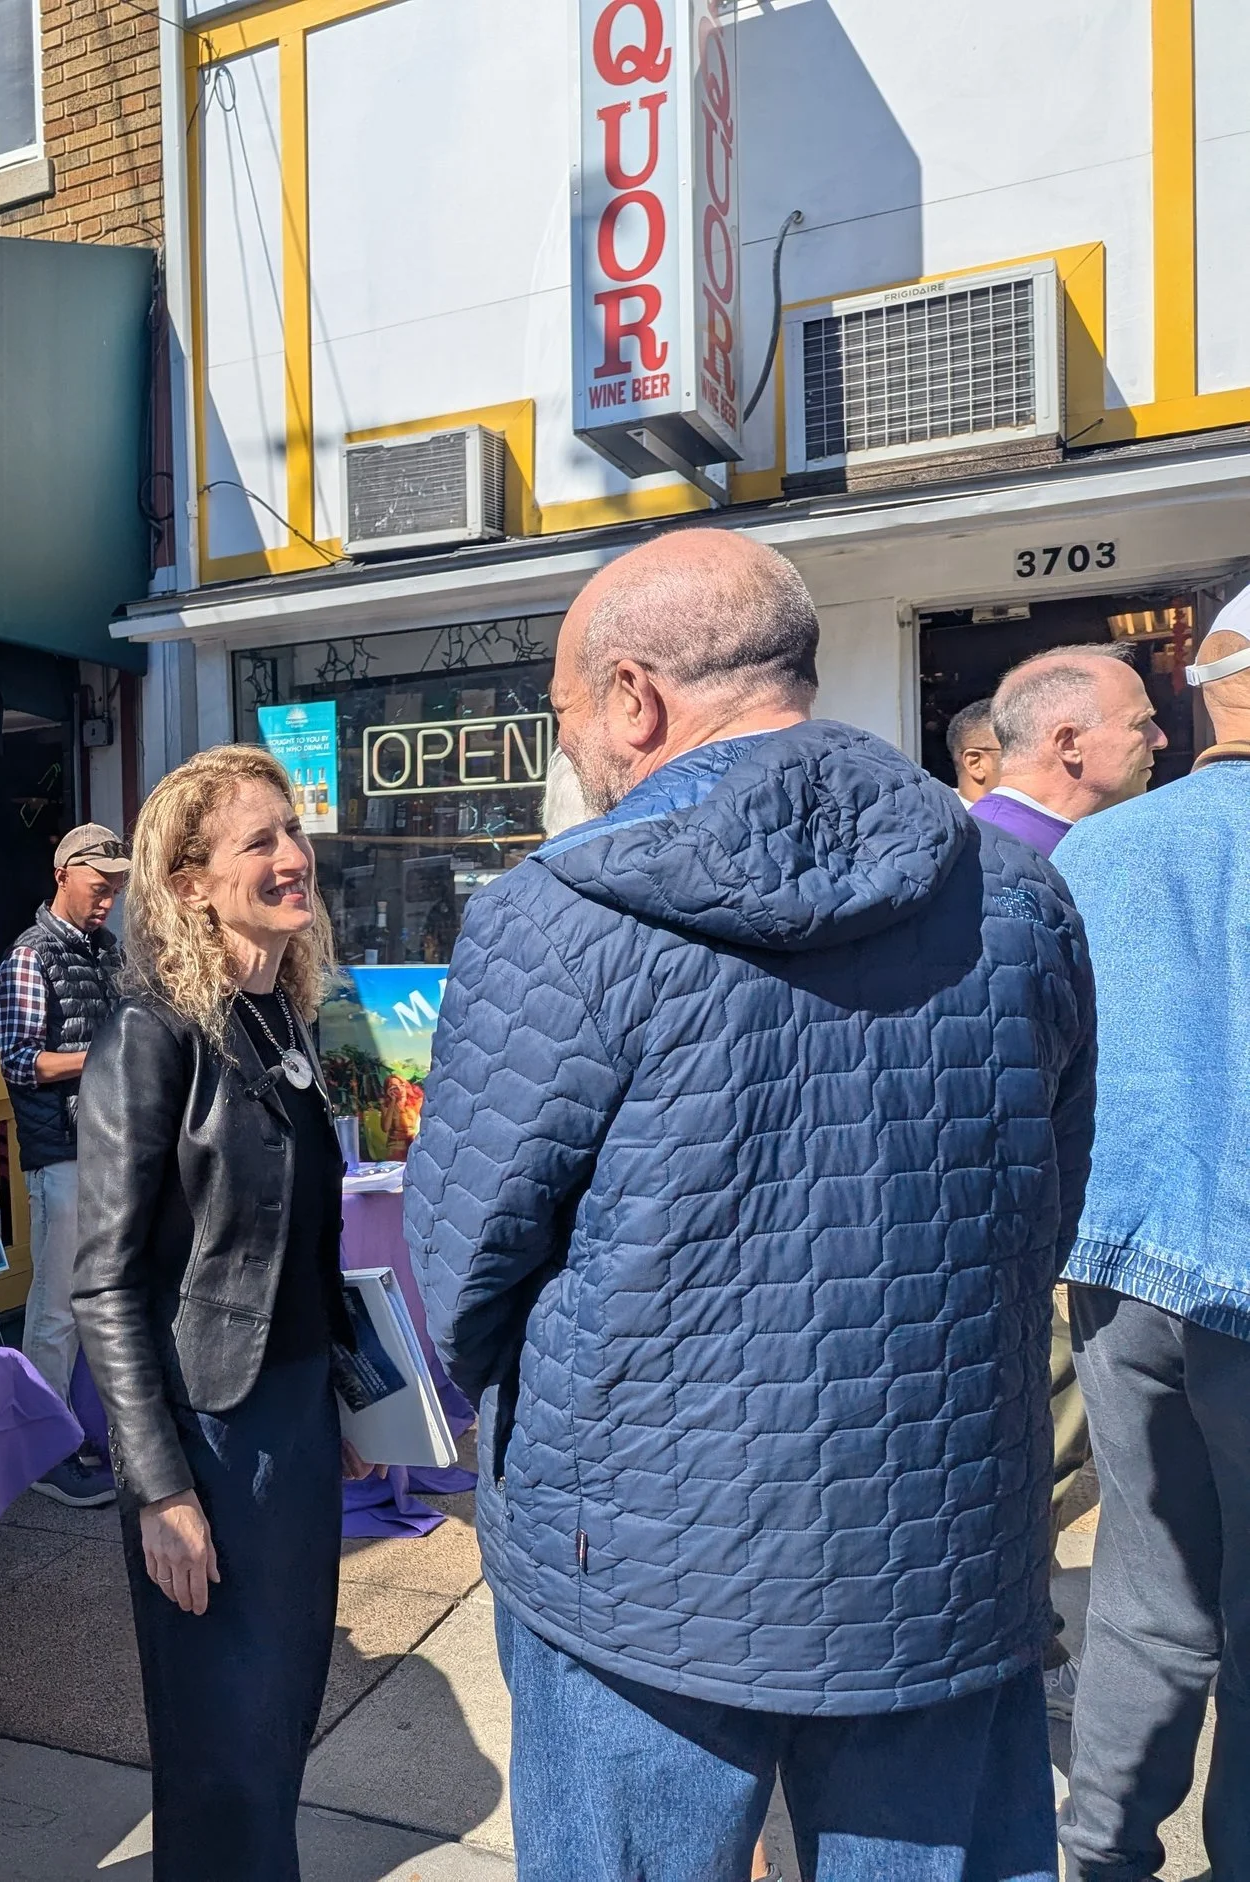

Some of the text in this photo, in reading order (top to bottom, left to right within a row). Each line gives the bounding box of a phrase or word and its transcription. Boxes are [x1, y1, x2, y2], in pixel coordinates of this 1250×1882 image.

[884, 283, 945, 301] FRIGIDAIRE
[589, 373, 670, 410] WINE BEER
[1016, 542, 1116, 578] 3703
[372, 721, 543, 788] OPEN
